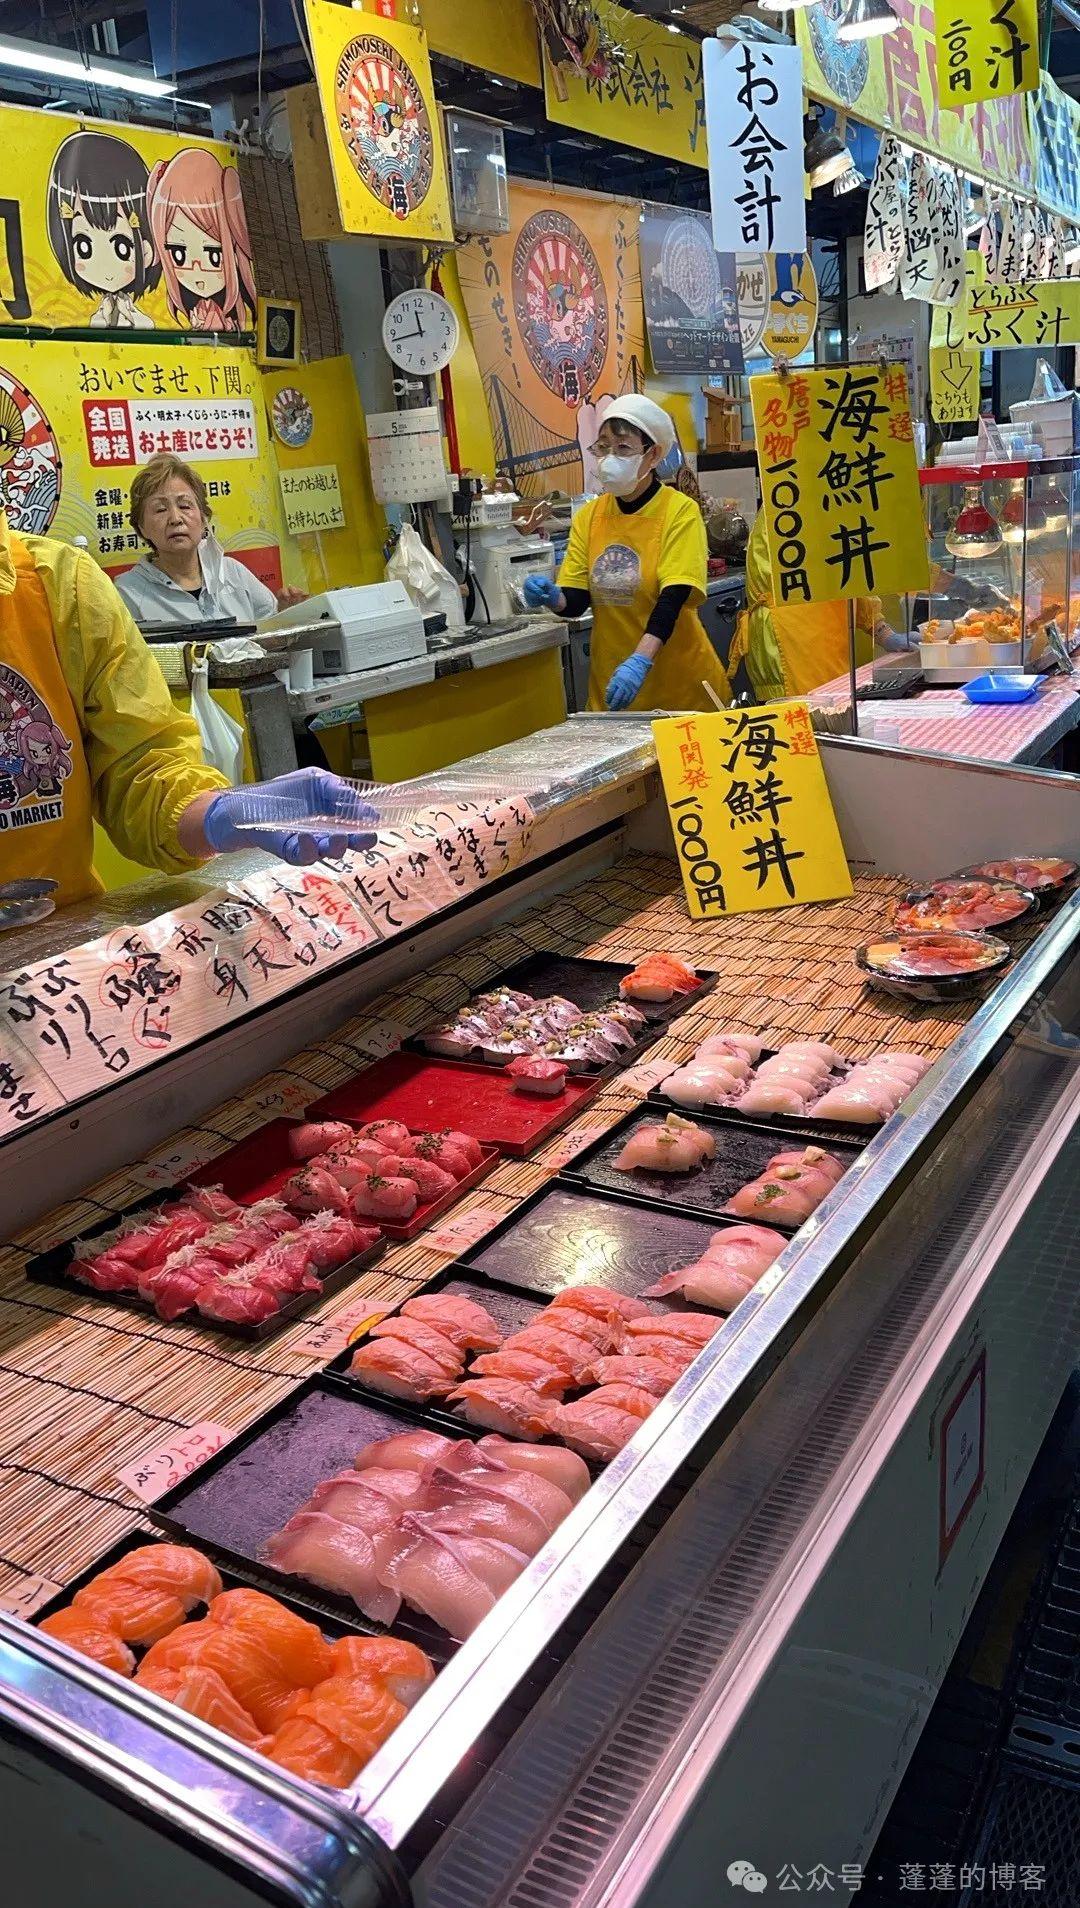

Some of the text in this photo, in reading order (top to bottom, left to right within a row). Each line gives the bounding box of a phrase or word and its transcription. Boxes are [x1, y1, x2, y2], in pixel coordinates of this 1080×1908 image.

[337, 38, 424, 112] SHIMONOSEKI JAPAN
[729, 45, 787, 250] お会計
[515, 213, 571, 283] SHIMONOSEKI
[401, 303, 410, 312] 11
[413, 298, 423, 307] 12
[430, 302, 434, 310] 1
[393, 314, 403, 323] 10
[440, 312, 446, 321] 2
[968, 306, 1070, 345] ふく汁
[390, 329, 396, 338] 9
[445, 326, 450, 335] 3
[396, 345, 402, 353] 8
[407, 354, 412, 362] 7
[432, 352, 438, 361] 5
[441, 342, 447, 351] 4
[420, 357, 426, 365] 6
[79, 363, 252, 395] おいでませ、下関。
[787, 377, 811, 441] 唐戸
[885, 372, 915, 442] 特選
[935, 389, 972, 405] こちらも
[88, 406, 127, 432] 全国
[938, 404, 973, 420] あります
[391, 422, 398, 433] 5
[761, 398, 794, 463] 名物
[92, 435, 130, 461] 発送
[283, 472, 338, 494] またのお越しを
[816, 371, 895, 592] 海鮮丼
[1, 671, 39, 711] JAPAN
[784, 705, 817, 758] 特選
[675, 721, 713, 792] 下関発
[11, 801, 62, 828] MARKET
[719, 712, 806, 899] 海鮮丼
[172, 923, 249, 1007] 赤身
[134, 1434, 204, 1487] ぶりトロ
